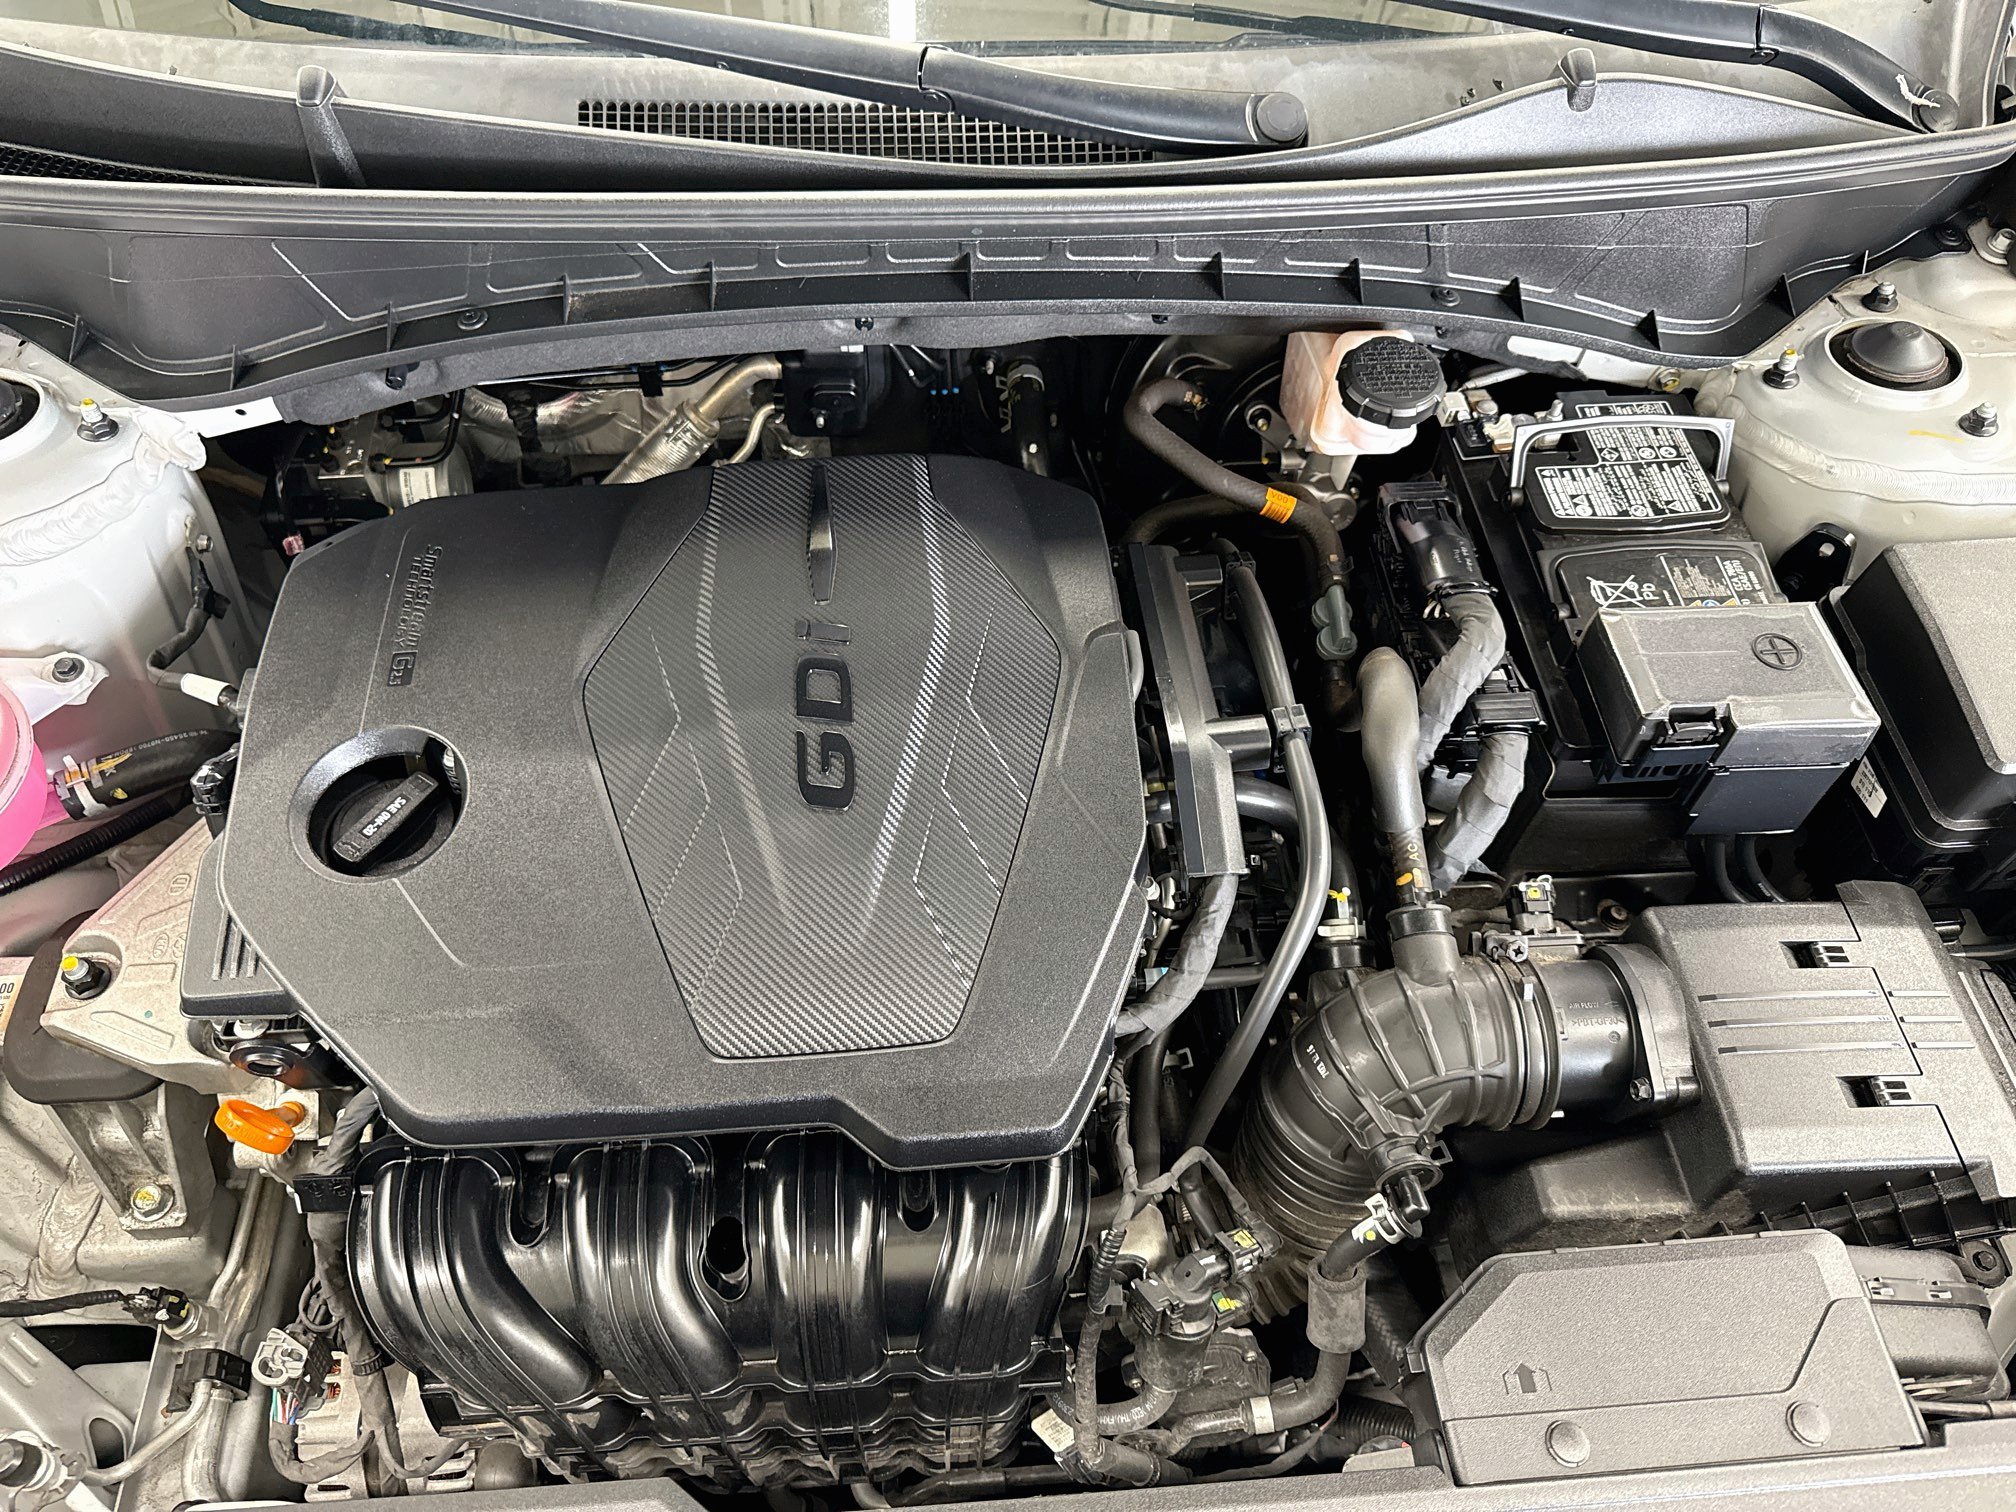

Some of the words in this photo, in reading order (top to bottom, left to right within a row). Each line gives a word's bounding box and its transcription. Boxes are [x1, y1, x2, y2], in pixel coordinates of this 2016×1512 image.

[1641, 582, 1659, 601] Pb
[387, 795, 407, 815] SAE
[362, 810, 391, 838] 0W-20
